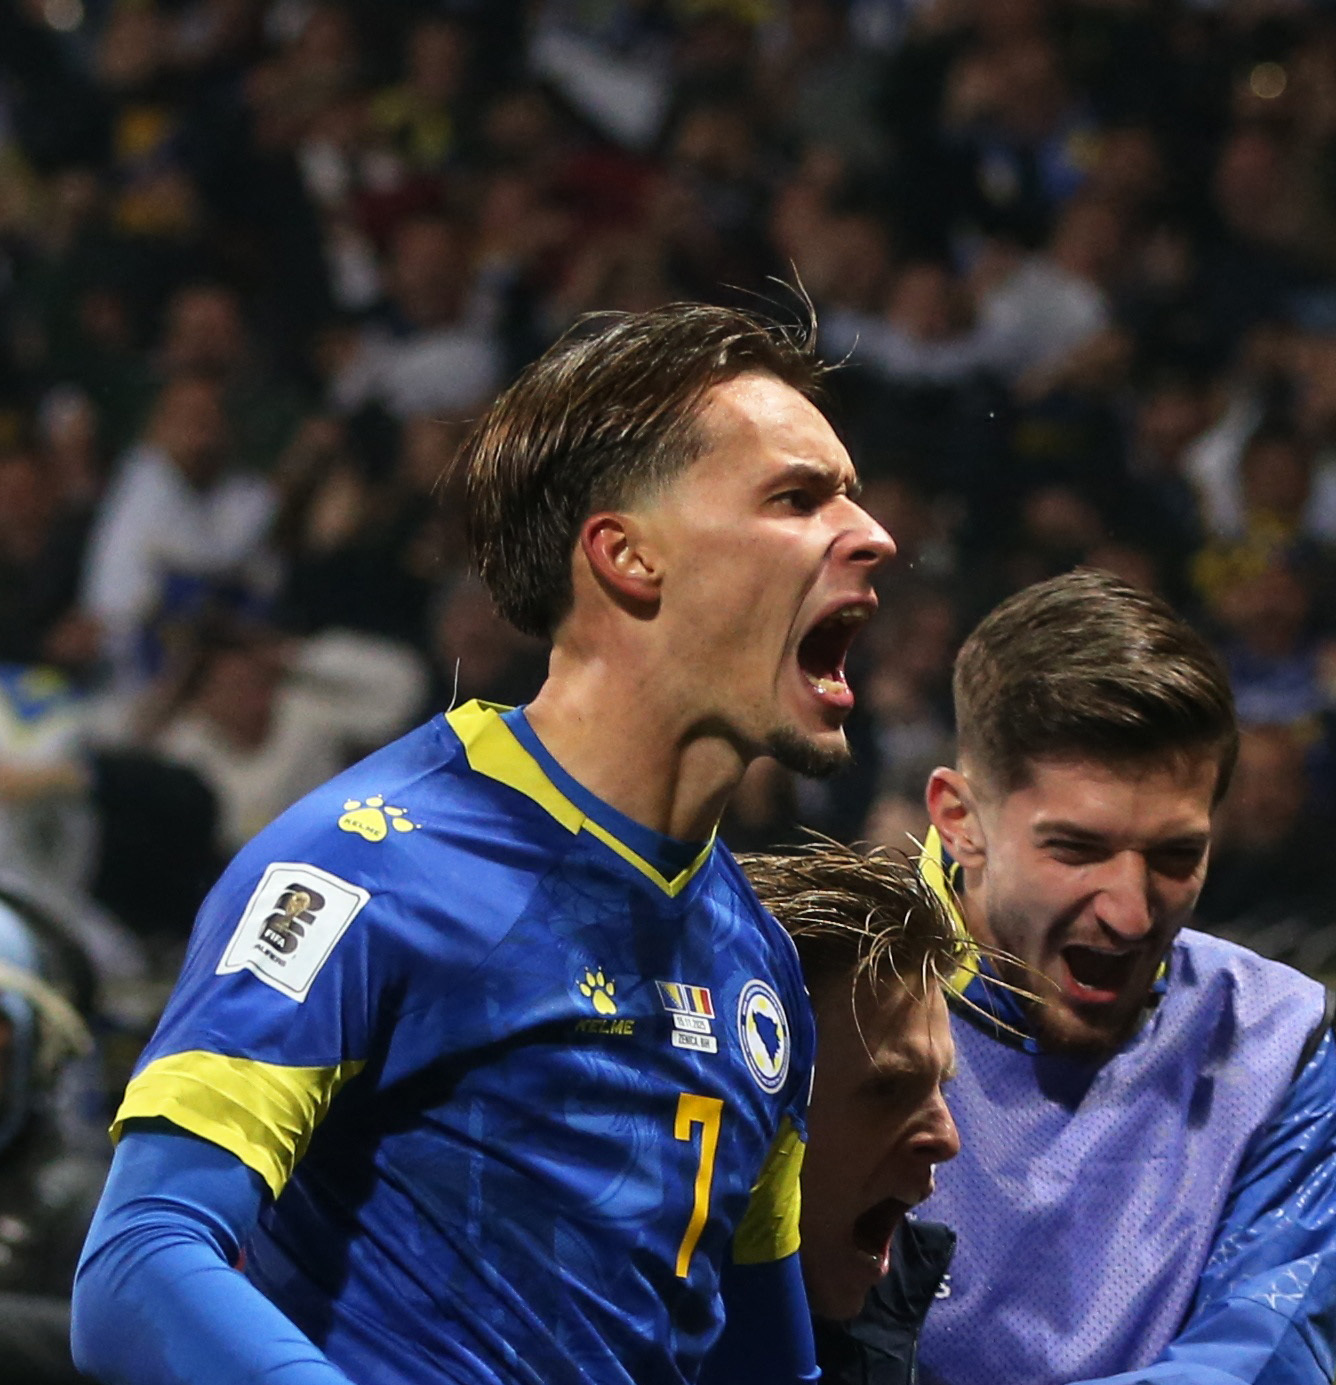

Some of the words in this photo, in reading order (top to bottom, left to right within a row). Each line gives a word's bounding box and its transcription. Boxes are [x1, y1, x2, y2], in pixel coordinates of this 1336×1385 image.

[264, 928, 286, 948] FIFA
[574, 1019, 635, 1036] KELME
[674, 1092, 725, 1279] 7
